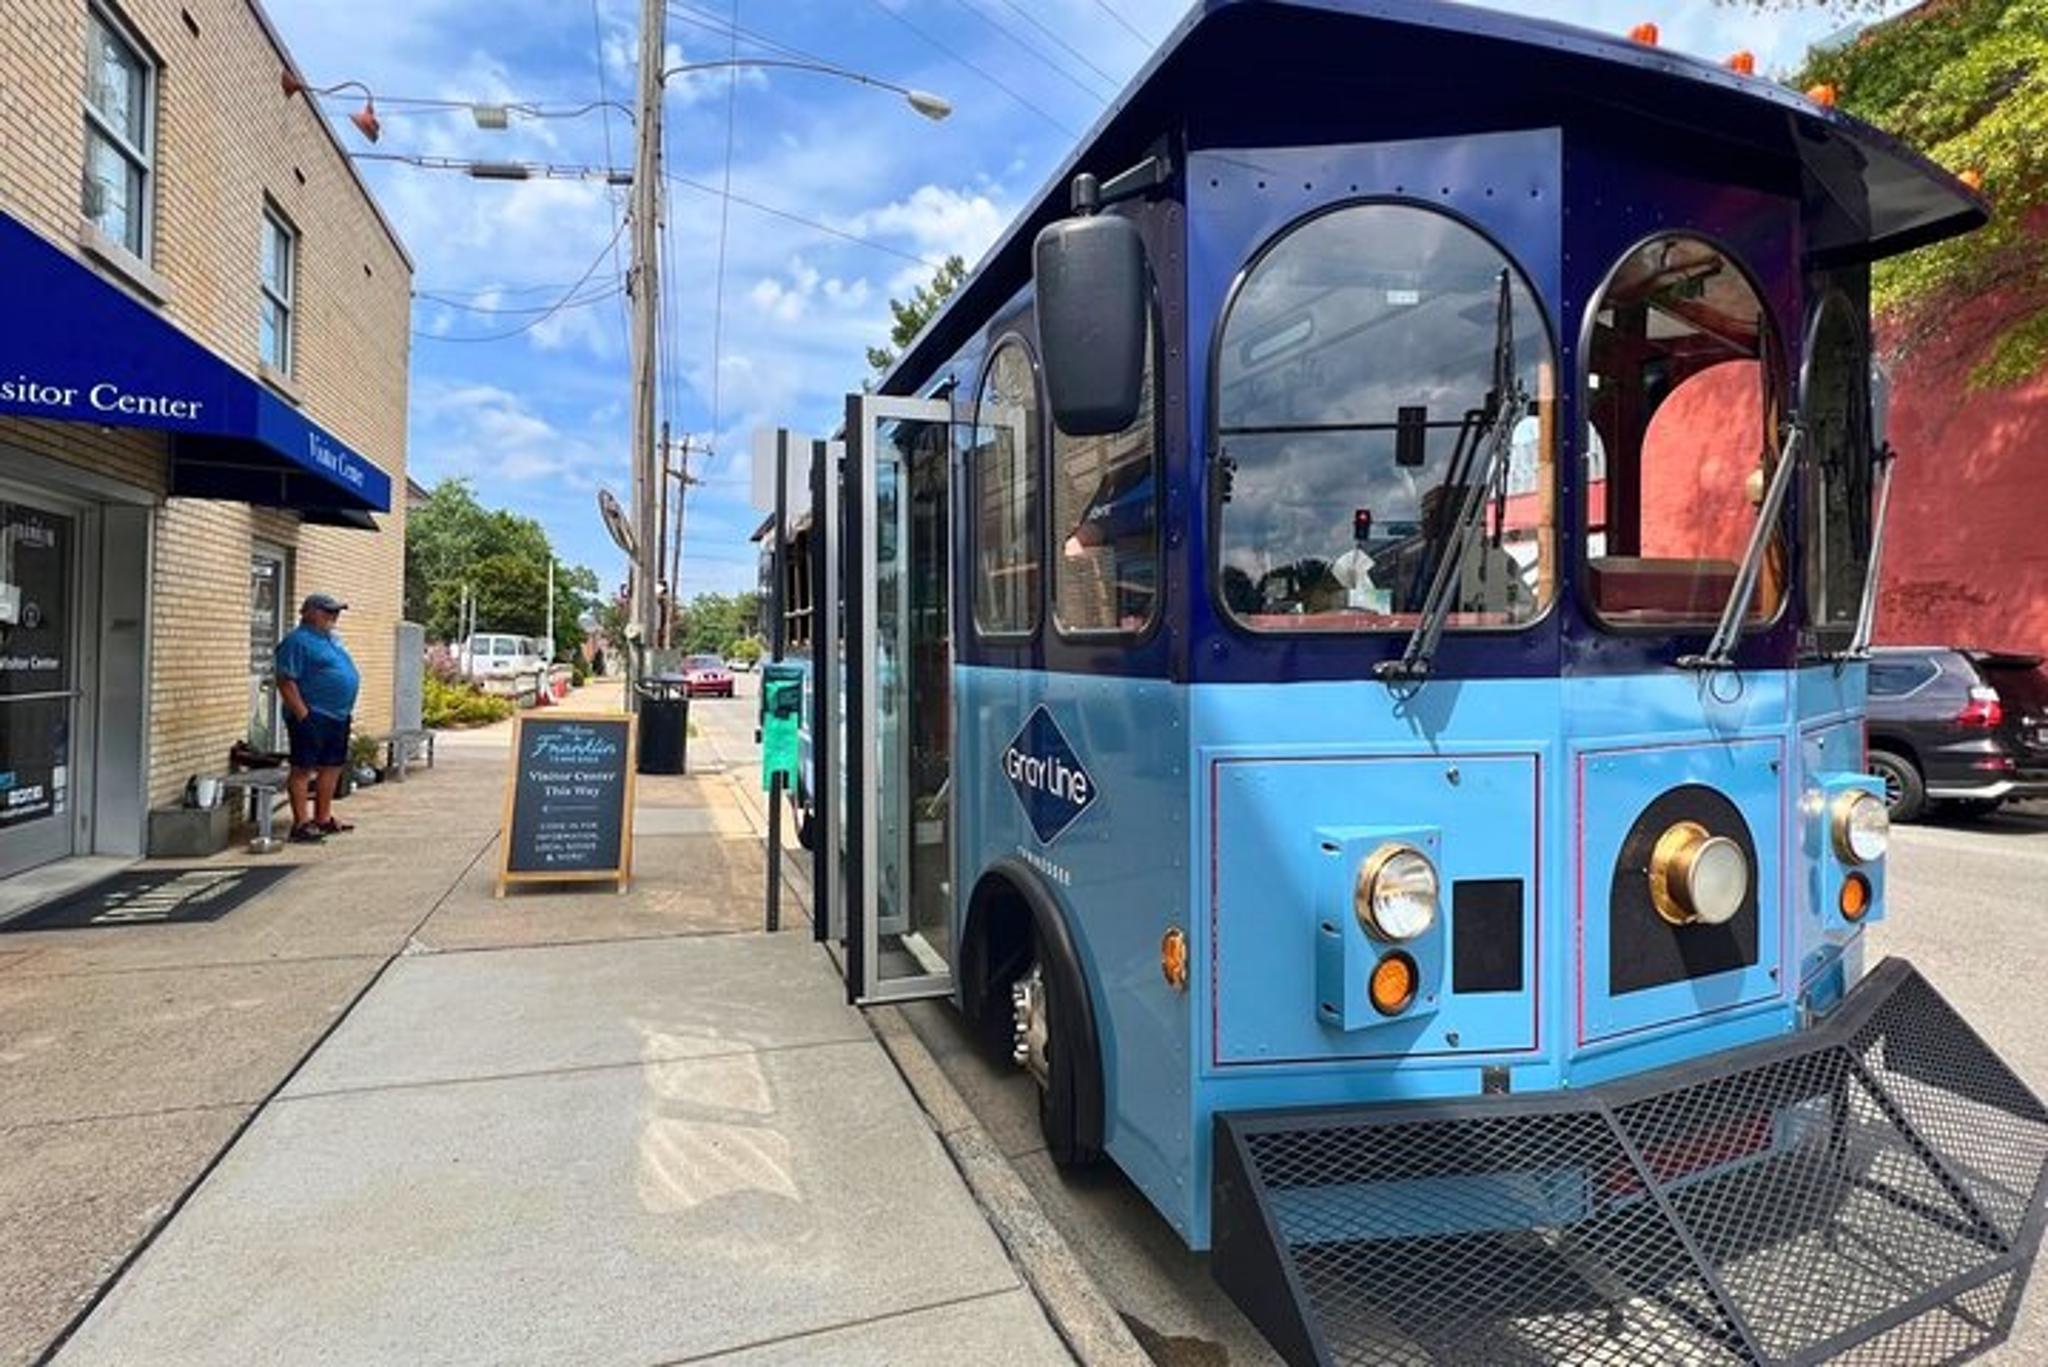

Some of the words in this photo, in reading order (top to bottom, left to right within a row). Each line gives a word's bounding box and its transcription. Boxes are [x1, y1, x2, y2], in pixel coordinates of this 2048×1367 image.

[89, 383, 203, 419] Center
[530, 734, 617, 758] Franklin
[529, 770, 571, 782] Visitor
[574, 771, 616, 782] Center
[545, 786, 571, 797] This
[575, 786, 600, 798] Way
